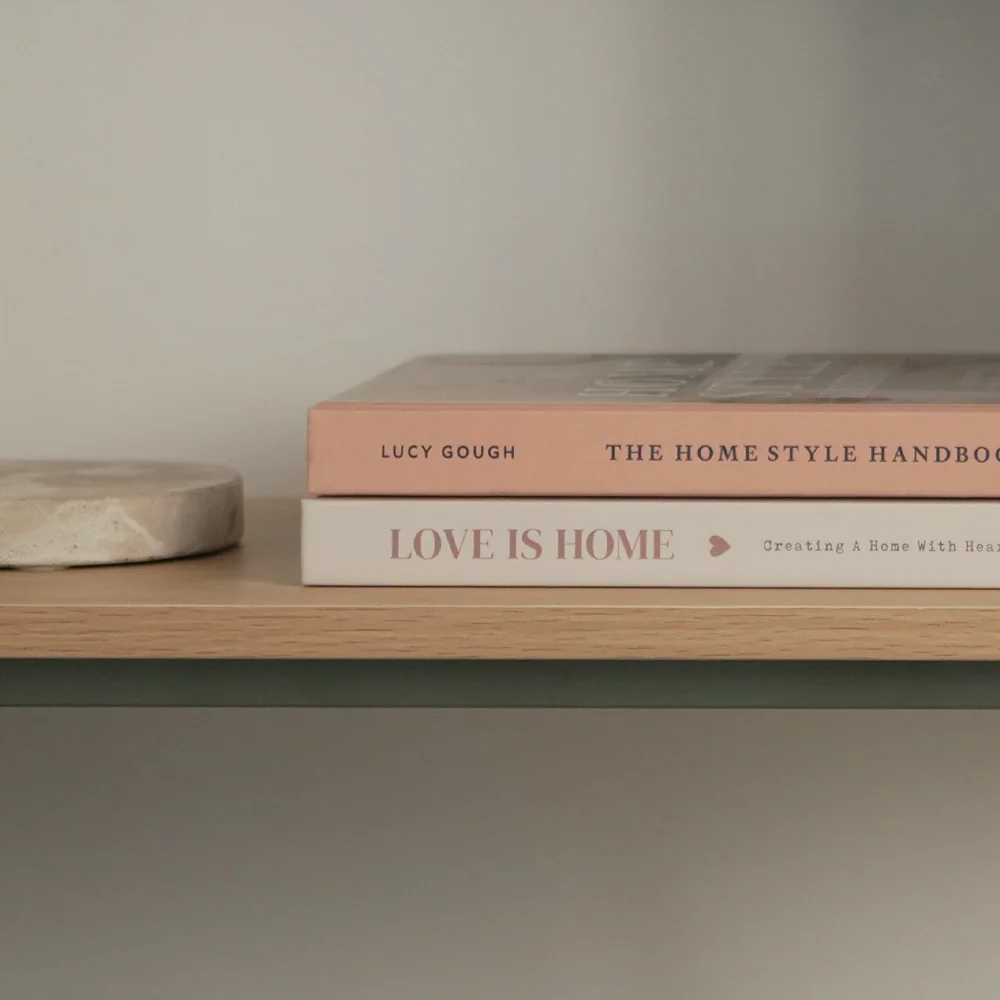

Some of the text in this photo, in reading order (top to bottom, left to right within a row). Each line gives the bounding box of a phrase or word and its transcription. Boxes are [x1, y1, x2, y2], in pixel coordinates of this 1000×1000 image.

[381, 444, 515, 460] LUCY GOUGH
[605, 444, 664, 462] THE
[674, 444, 758, 462] HOME
[767, 444, 857, 463] STYLE
[390, 528, 675, 561] LOVE IS HOME
[763, 539, 845, 555] Creating
[852, 540, 861, 552] A
[869, 540, 910, 552] Home
[917, 540, 957, 553] With
